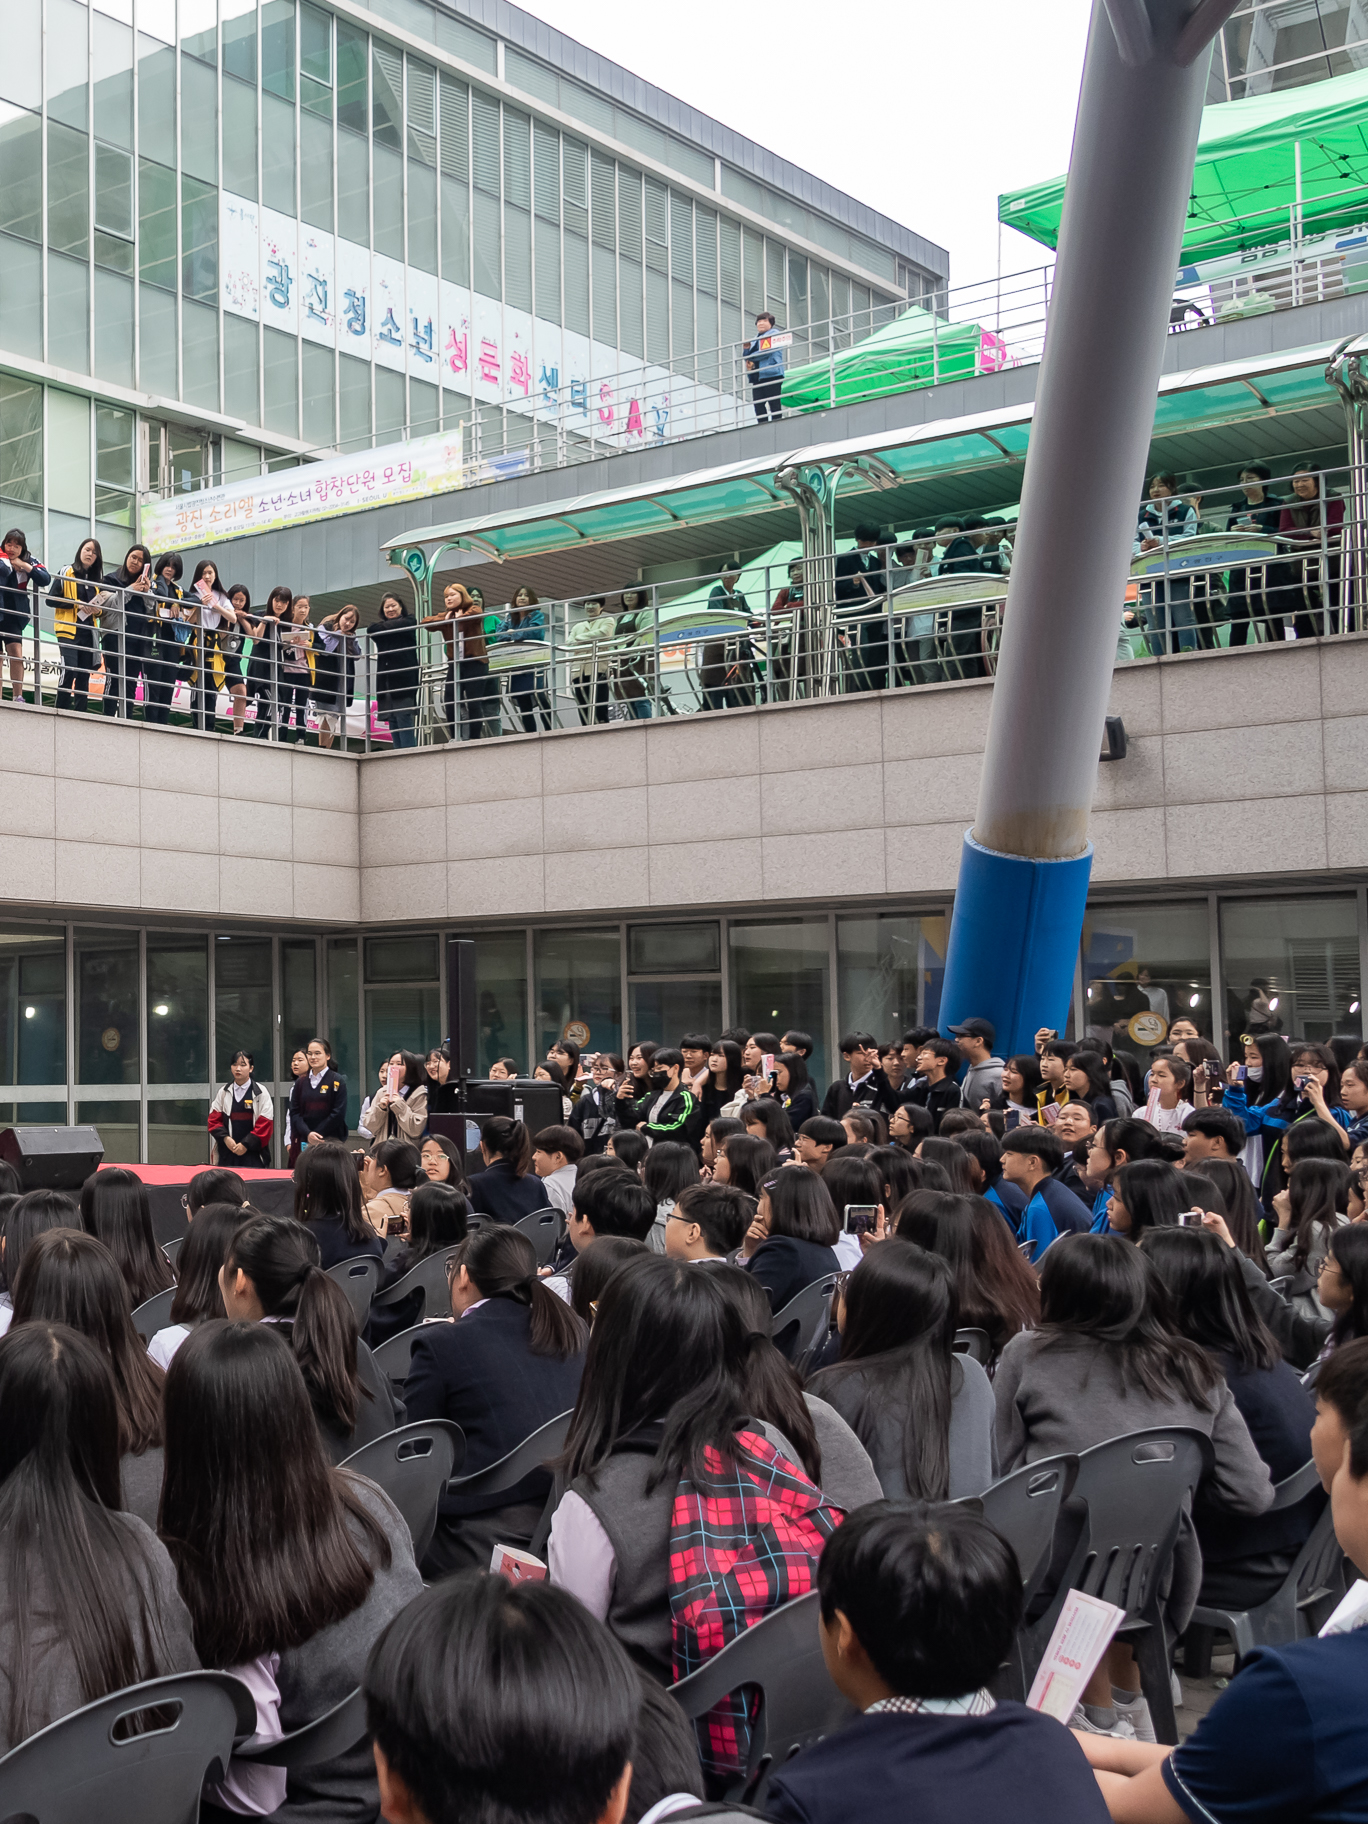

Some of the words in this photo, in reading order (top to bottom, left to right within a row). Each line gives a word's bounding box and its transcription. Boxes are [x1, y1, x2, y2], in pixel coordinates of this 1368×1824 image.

[175, 508, 204, 532] 광진
[208, 496, 254, 525] 소리엘
[314, 469, 376, 502] 합창단원
[381, 460, 412, 485] 모집
